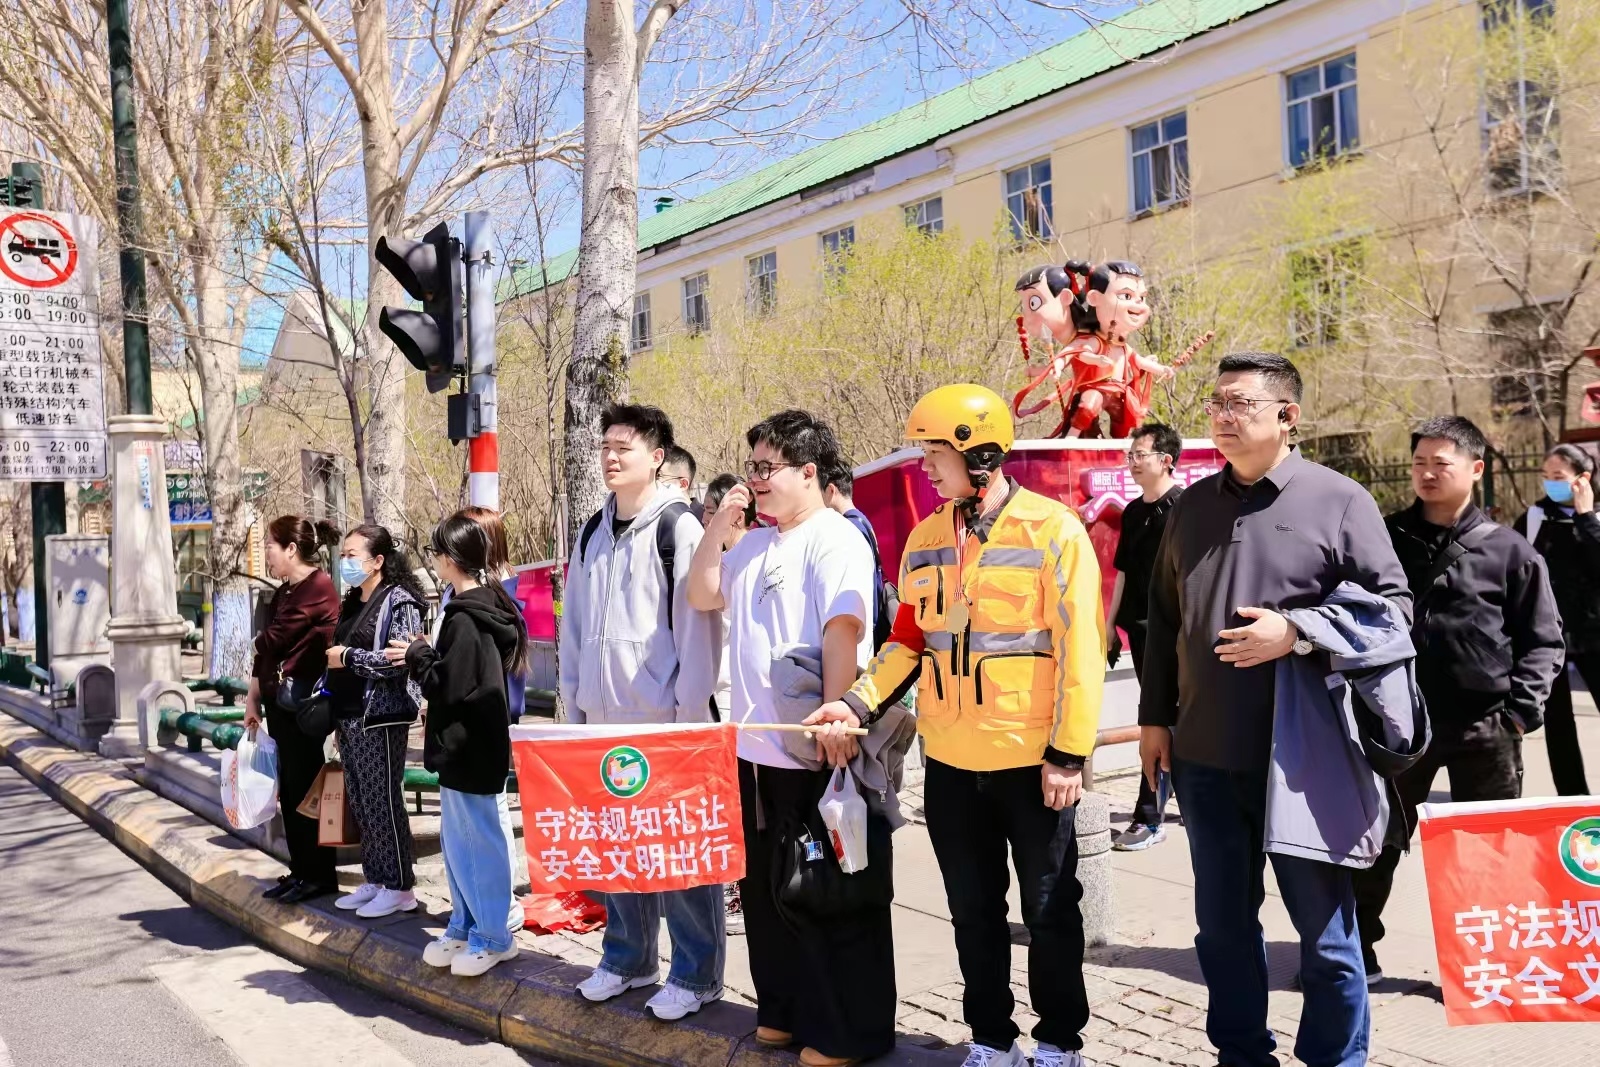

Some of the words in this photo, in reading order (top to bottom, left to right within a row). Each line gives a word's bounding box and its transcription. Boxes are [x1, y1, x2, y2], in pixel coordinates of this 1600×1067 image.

[3, 380, 80, 395] 轮式装载车
[16, 412, 77, 426] 低速货车
[535, 794, 728, 843] 守法规知礼让
[541, 834, 732, 881] 安全文明出行
[1454, 900, 1600, 954] 守法规
[1463, 953, 1600, 1010] 安全文
